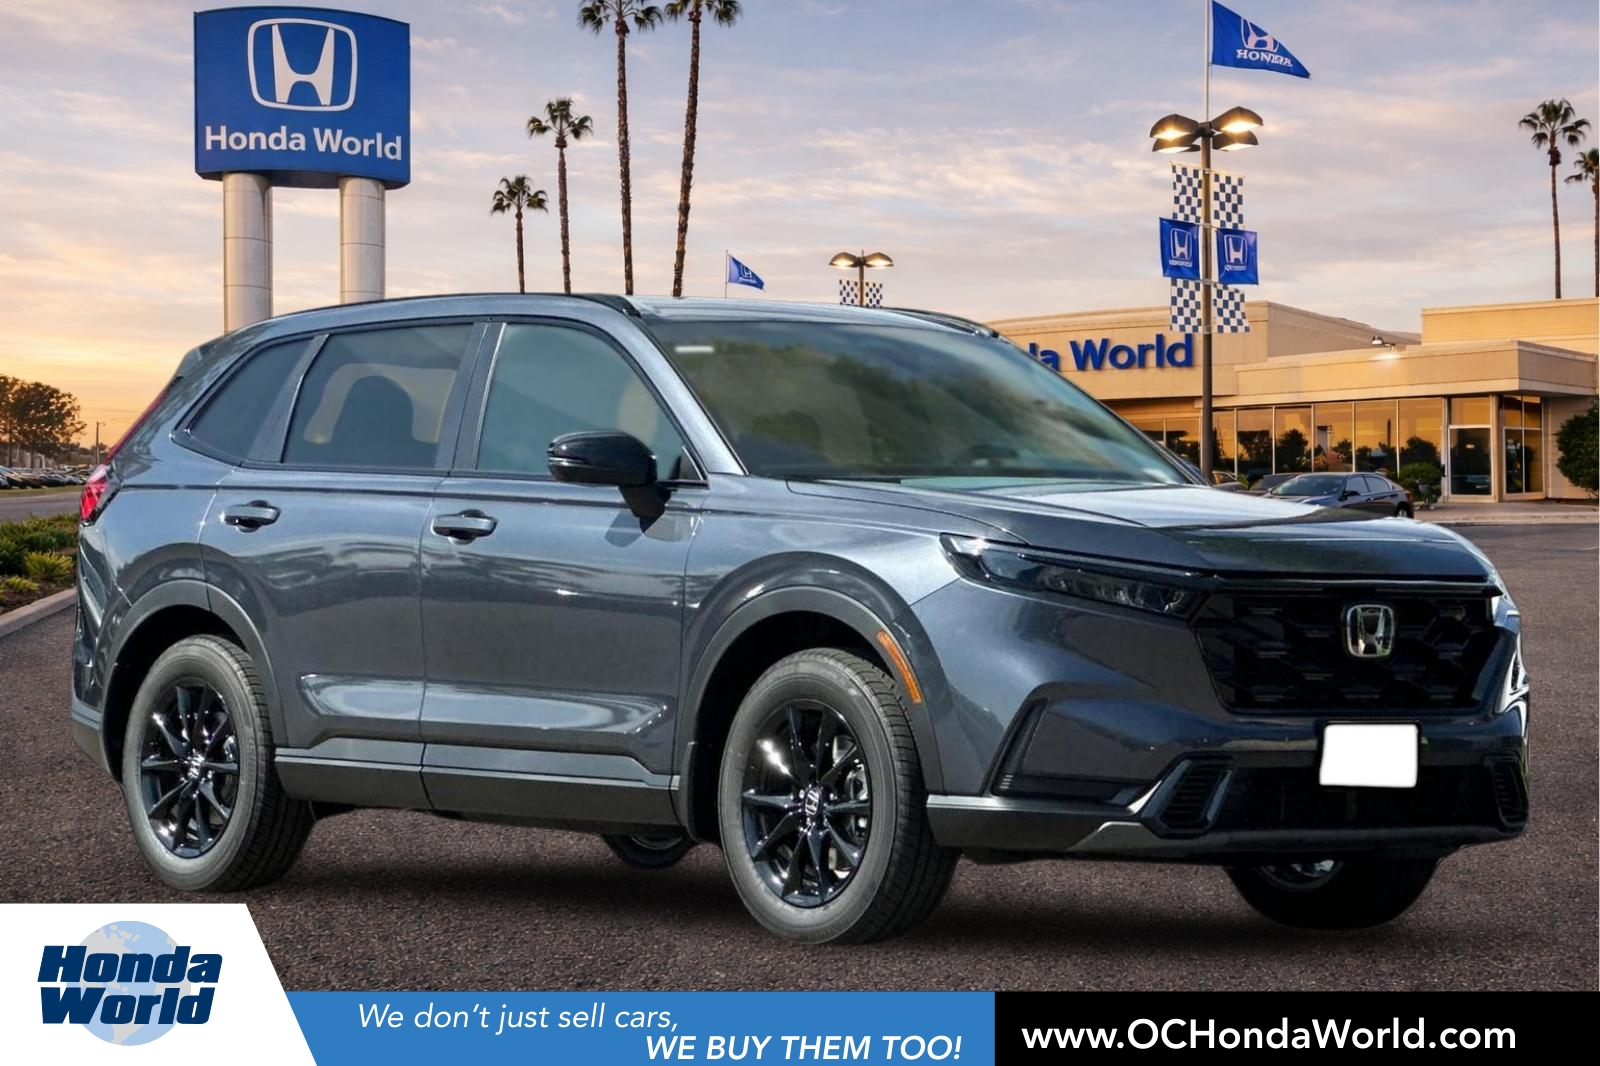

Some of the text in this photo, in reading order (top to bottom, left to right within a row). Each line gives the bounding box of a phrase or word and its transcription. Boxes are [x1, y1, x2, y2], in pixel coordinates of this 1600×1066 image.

[205, 125, 402, 161] Honda World
[1069, 333, 1194, 371] World
